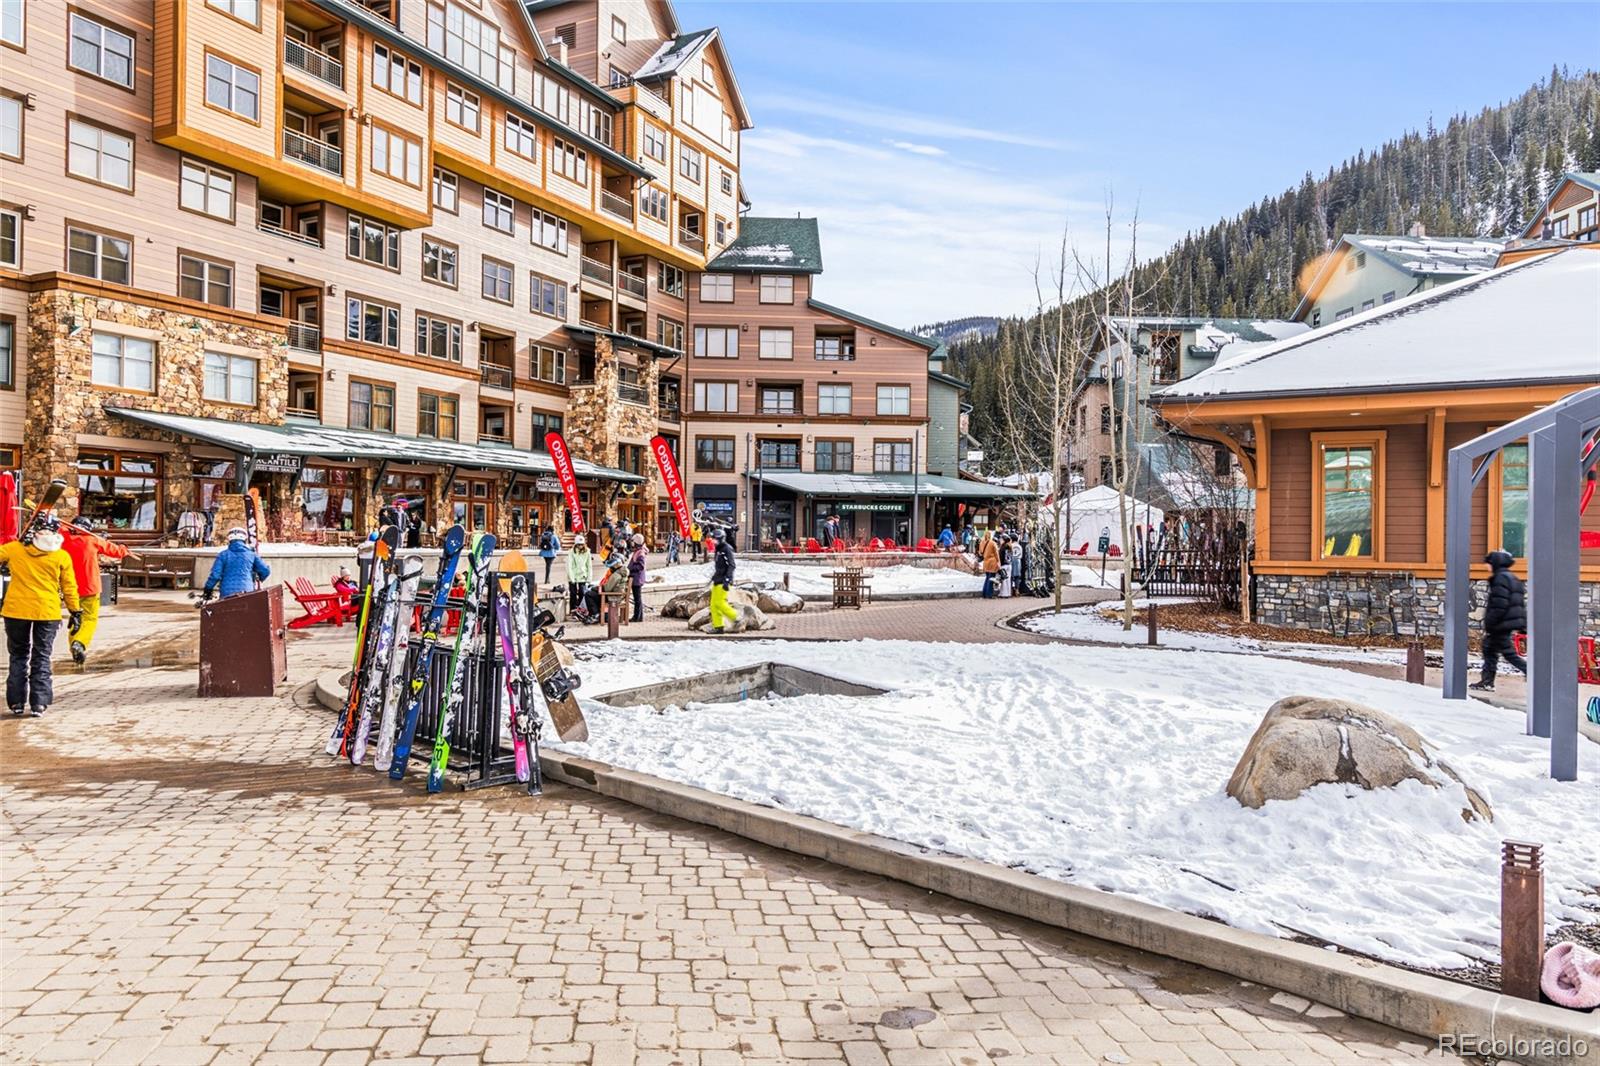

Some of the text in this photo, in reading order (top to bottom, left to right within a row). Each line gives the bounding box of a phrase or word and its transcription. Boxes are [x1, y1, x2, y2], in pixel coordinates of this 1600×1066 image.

[243, 455, 297, 467] MCANTILE
[552, 440, 572, 483] FARGO
[657, 444, 690, 532] WELLS FARGO
